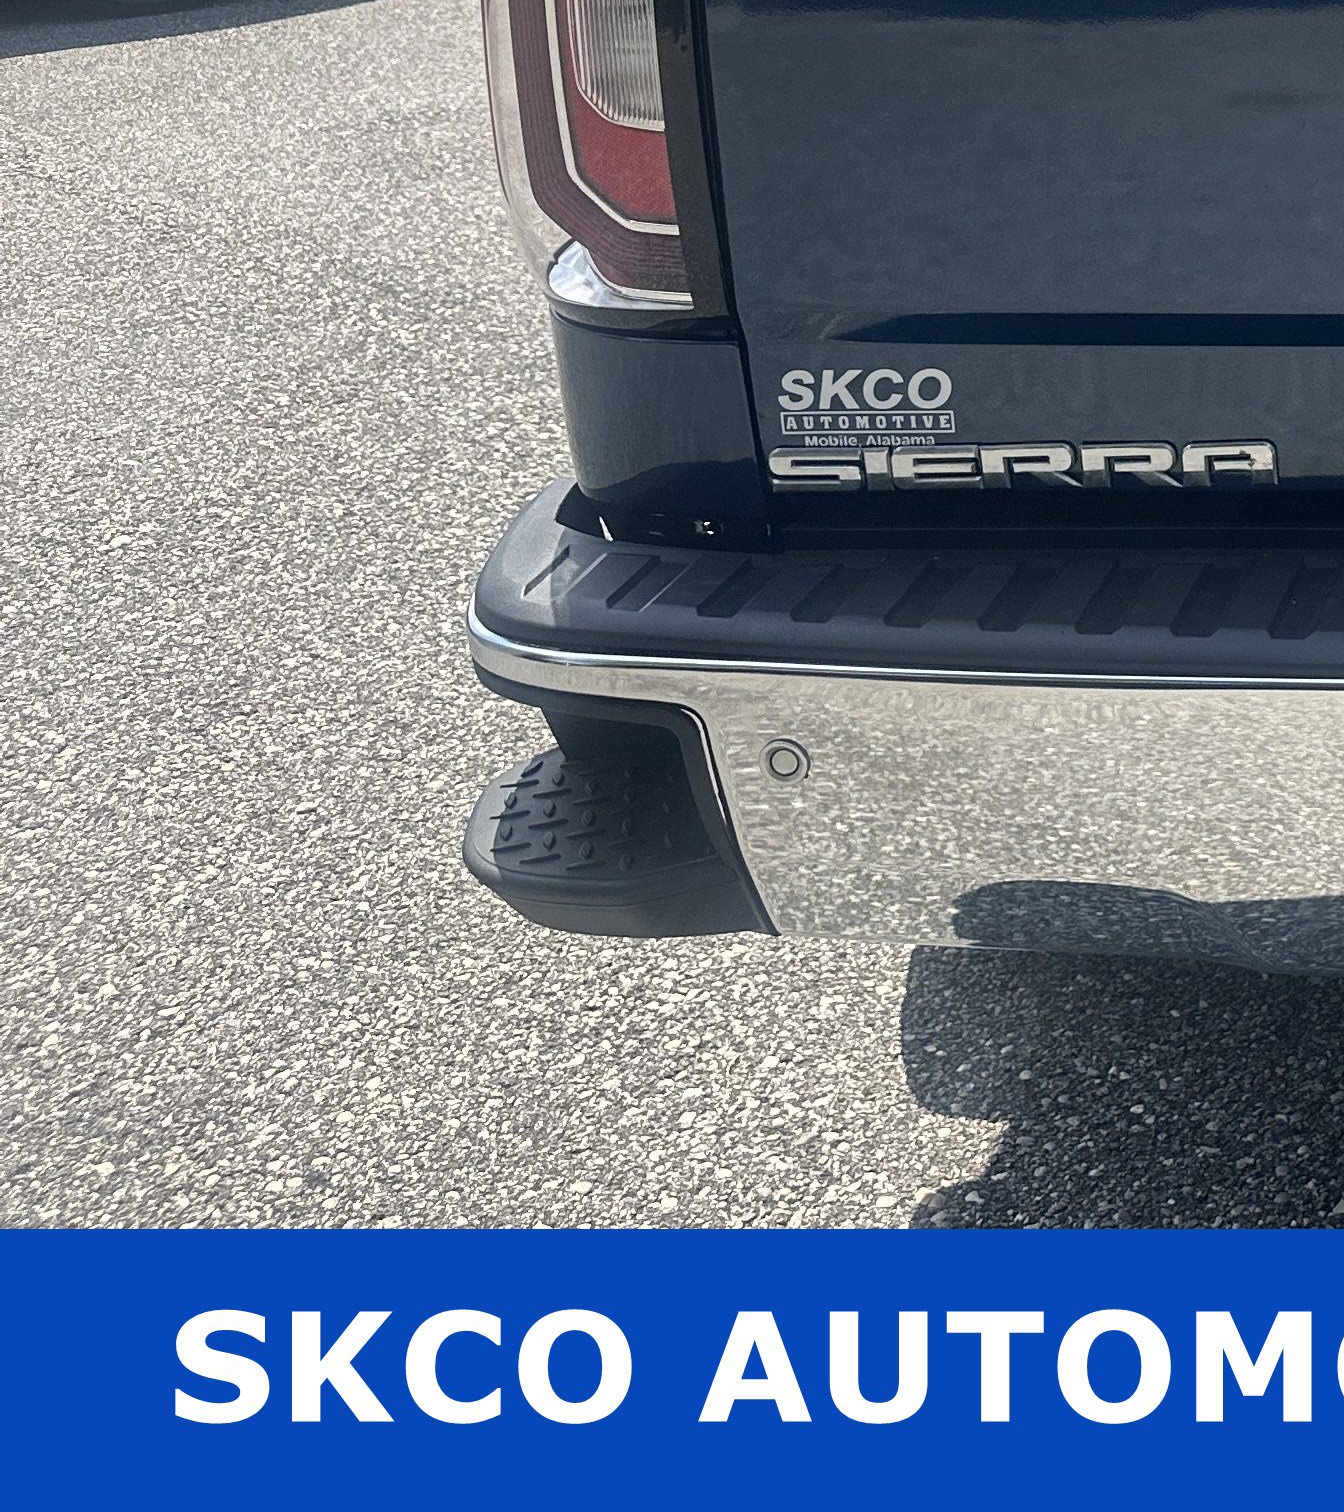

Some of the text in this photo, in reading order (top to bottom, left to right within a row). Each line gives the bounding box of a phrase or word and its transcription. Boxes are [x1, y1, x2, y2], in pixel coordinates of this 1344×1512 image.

[777, 367, 953, 411] SKCO
[786, 414, 952, 431] AUTOMOTIVE
[804, 435, 936, 447] Mobile, Alabama
[768, 442, 1277, 491] SIERRA
